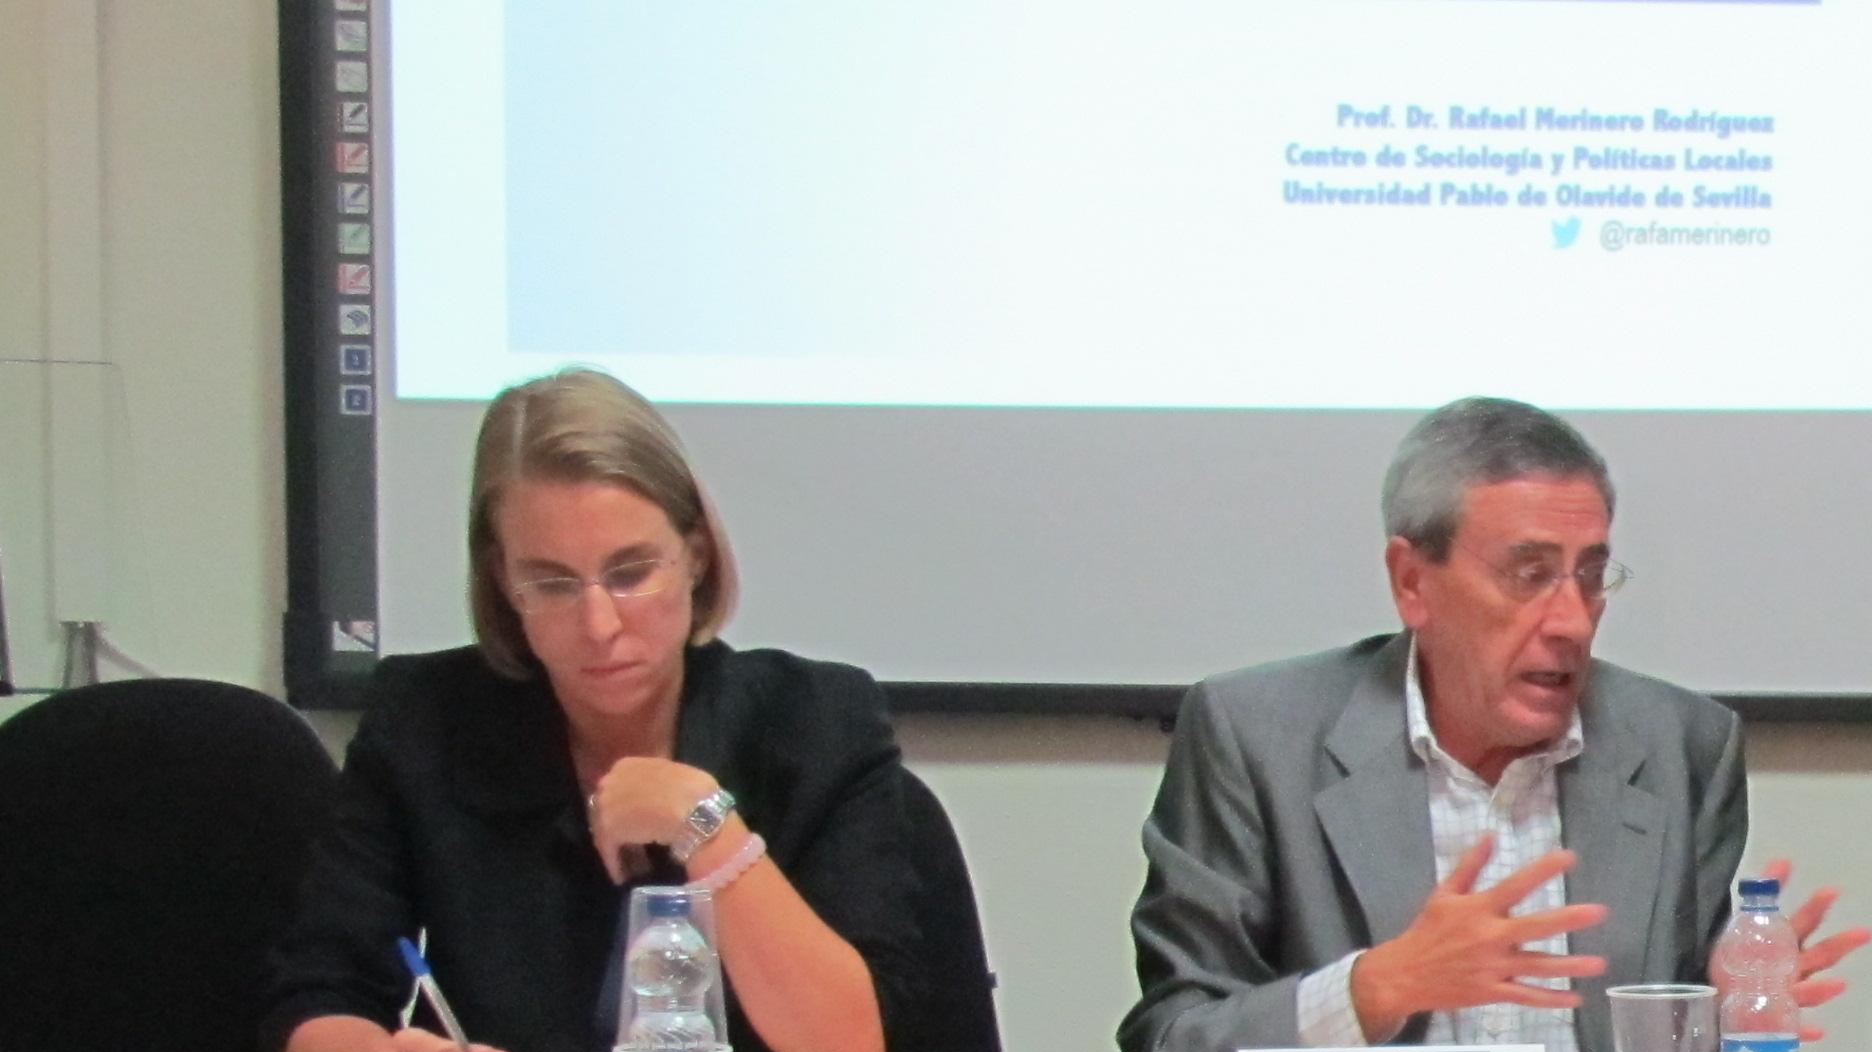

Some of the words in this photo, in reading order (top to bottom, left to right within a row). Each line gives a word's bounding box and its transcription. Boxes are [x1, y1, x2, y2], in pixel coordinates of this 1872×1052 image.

[1337, 104, 1395, 129] Prof.
[1407, 106, 1438, 130] Dr.
[1449, 107, 1525, 131] Rafael
[1535, 109, 1644, 133] Merinero
[1653, 110, 1774, 138] Rodríguez
[1285, 144, 1368, 167] Centro
[1375, 145, 1406, 168] de
[1414, 146, 1543, 175] Sociología
[1551, 153, 1564, 176] y
[1574, 148, 1676, 171] Políticas
[1684, 149, 1773, 172] Locales
[1284, 181, 1431, 205] Universidad
[1441, 183, 1508, 206] Pablo
[1517, 184, 1548, 206] de
[1556, 185, 1645, 208] Olavide
[1655, 186, 1683, 208] de
[1693, 187, 1772, 208] Sevilla
[1600, 220, 1771, 250] @rafamerinero
